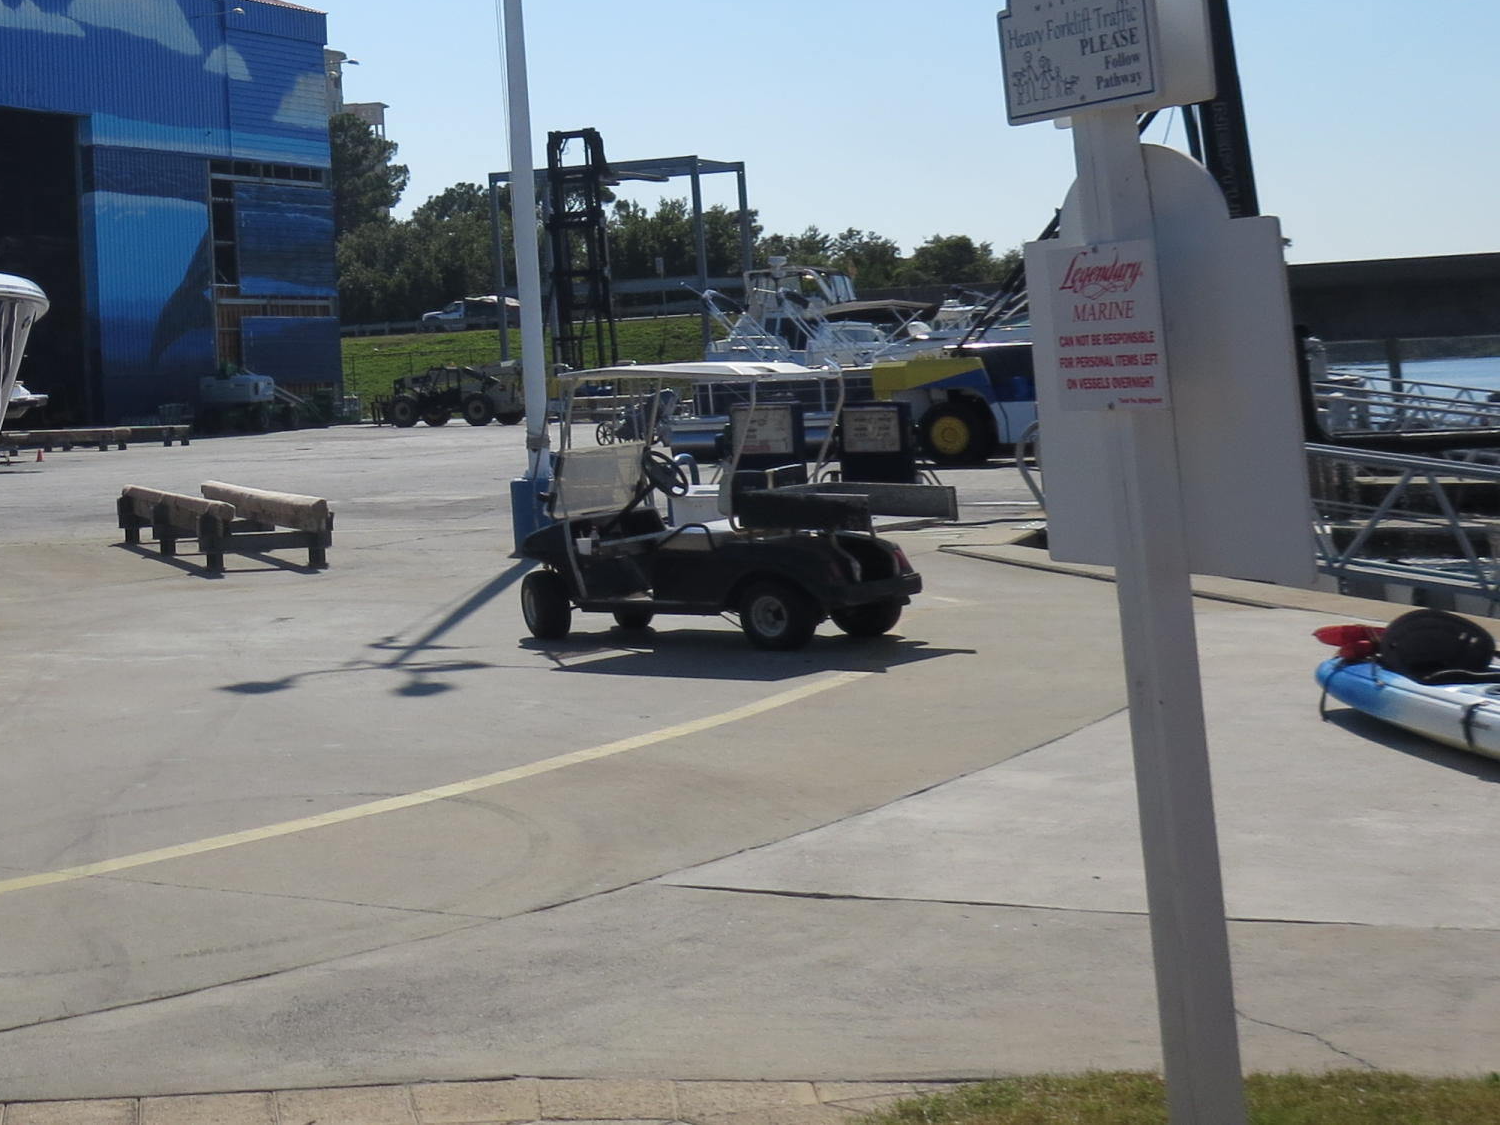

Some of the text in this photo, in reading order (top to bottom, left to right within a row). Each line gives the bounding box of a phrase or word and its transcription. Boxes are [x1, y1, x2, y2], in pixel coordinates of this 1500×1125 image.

[1007, 28, 1045, 52] Heavy
[1045, 7, 1093, 41] Forklift
[1079, 26, 1140, 56] PLEASE
[1104, 52, 1140, 70] Follow
[1095, 71, 1143, 91] Pathway
[1059, 248, 1142, 294] Legendary
[1072, 300, 1135, 323] MARINE
[1059, 331, 1155, 348] CAN NOT BE RESPONSIBLE
[1059, 353, 1158, 369] FOR PERSONAL ITEMS LEFT
[1067, 376, 1155, 390] ON VESSELS OVERNIGHT
